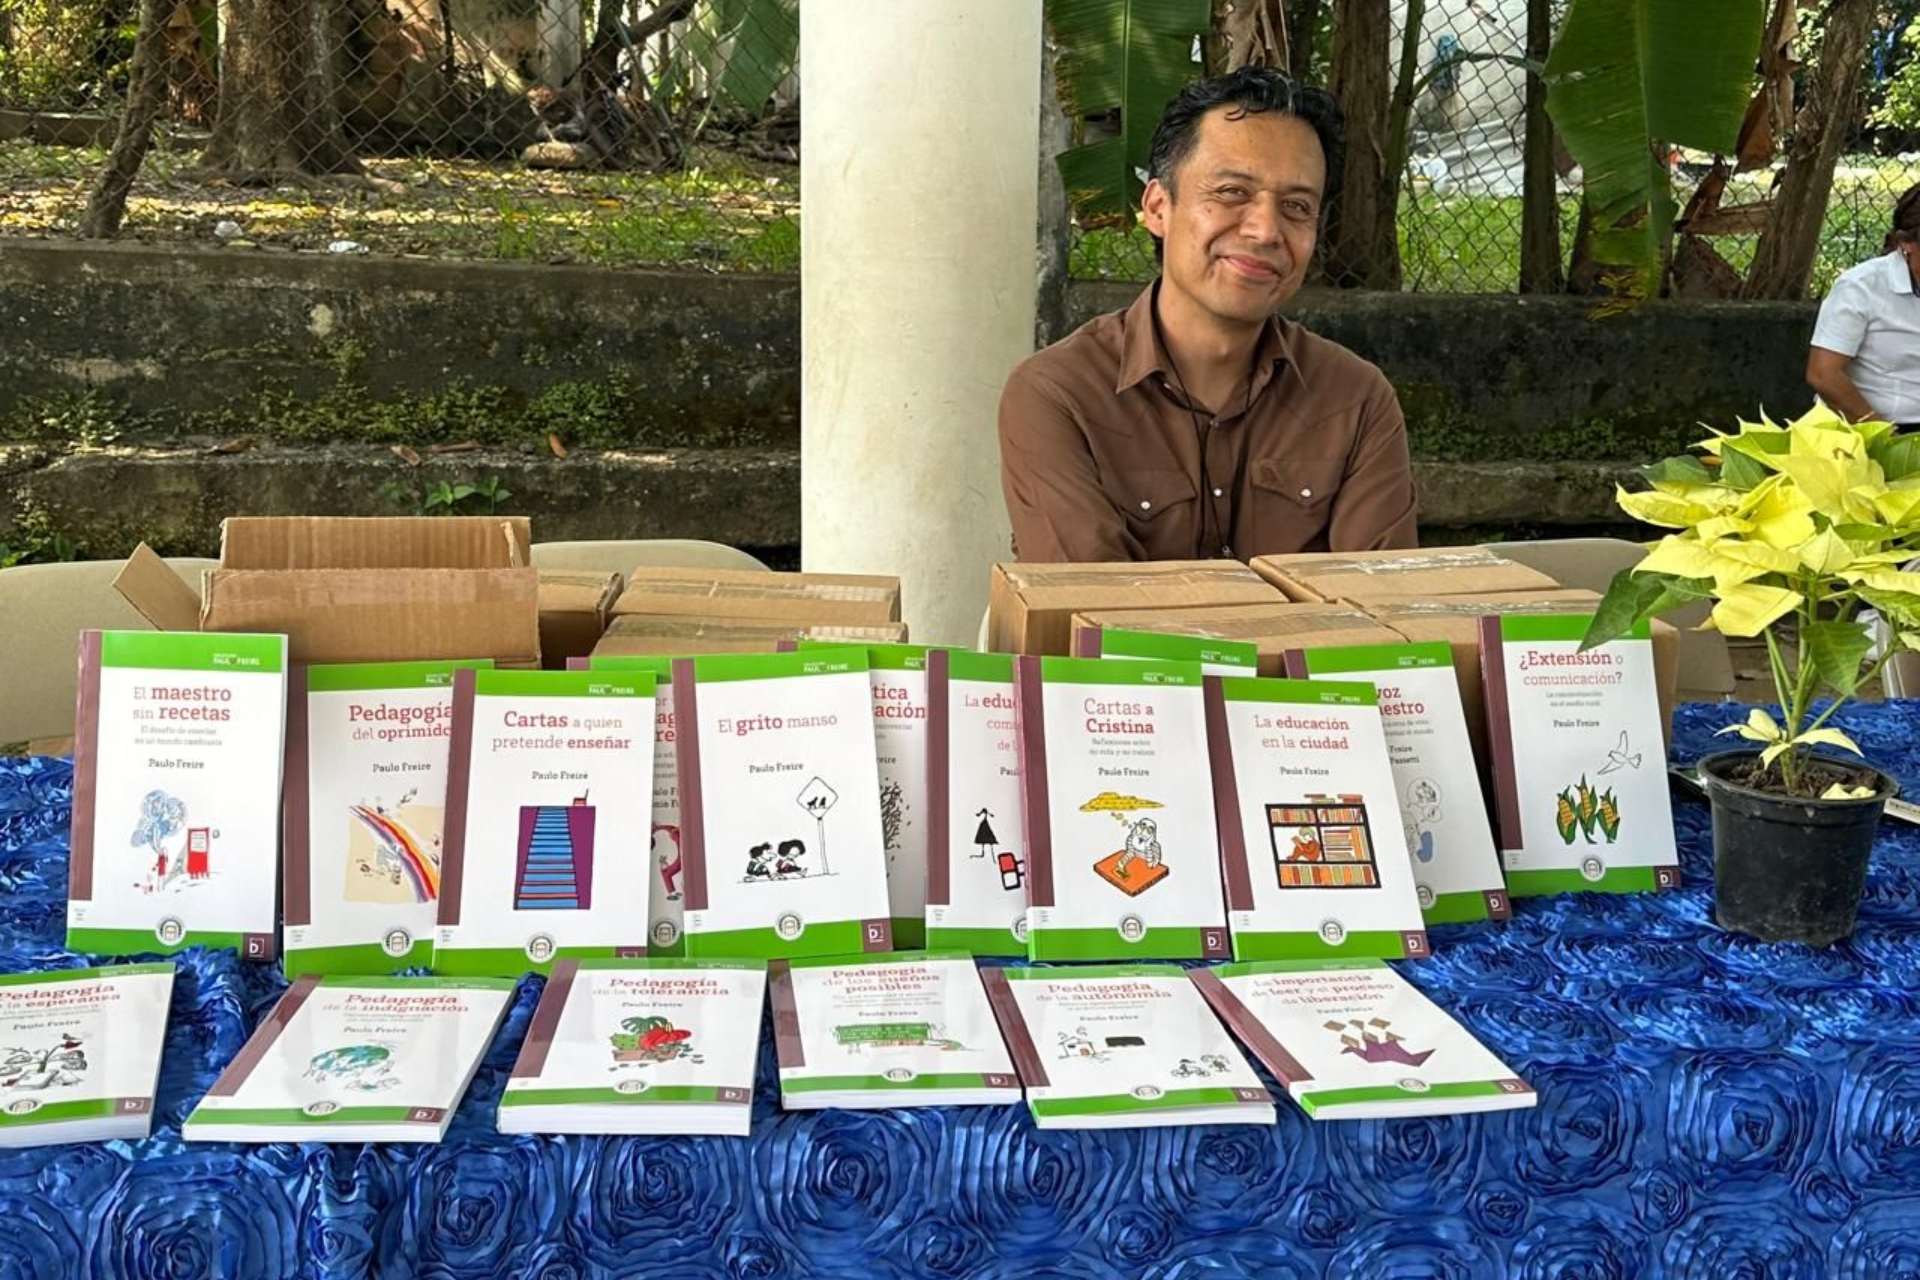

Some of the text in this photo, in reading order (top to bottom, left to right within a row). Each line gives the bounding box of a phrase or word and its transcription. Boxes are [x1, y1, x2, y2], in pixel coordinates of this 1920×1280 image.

[1519, 650, 1624, 670] ¿Extensión o
[1523, 671, 1623, 686] comunicación?
[134, 685, 232, 701] El maestro
[872, 683, 908, 700] tica
[965, 694, 979, 707] La
[1084, 697, 1155, 716] Cartas a
[133, 705, 231, 721] sin recetas
[348, 701, 453, 724] Pedagogía
[873, 702, 926, 718] ación
[503, 710, 623, 732] Cartas a quien
[718, 714, 838, 736] El grito manso
[1086, 718, 1155, 734] Cristina
[1254, 713, 1350, 730] La educación
[1553, 719, 1600, 728] Paulo Freire
[352, 727, 374, 741] del
[492, 734, 632, 752] pretende enseñar
[1262, 735, 1350, 750] en la ciudad
[148, 758, 205, 769] Paulo Freire
[373, 762, 431, 773] Paulo Freire
[749, 762, 804, 773] Paulo Freire
[532, 770, 588, 780] Paulo Freire
[1098, 767, 1150, 777] Paulo Freire
[1280, 766, 1330, 776] Paulo Freire
[832, 967, 927, 978] Pedagogía
[610, 978, 718, 988] Pedagogía
[1273, 974, 1373, 985] importancia
[631, 986, 730, 996] tolerancia
[845, 983, 922, 994] posibles
[1048, 982, 1153, 993] Pedagogía
[26, 994, 121, 1007] esperanza
[345, 994, 458, 1005] Pedagogía
[1072, 989, 1172, 1001] autonomía
[361, 1003, 469, 1013] indignación
